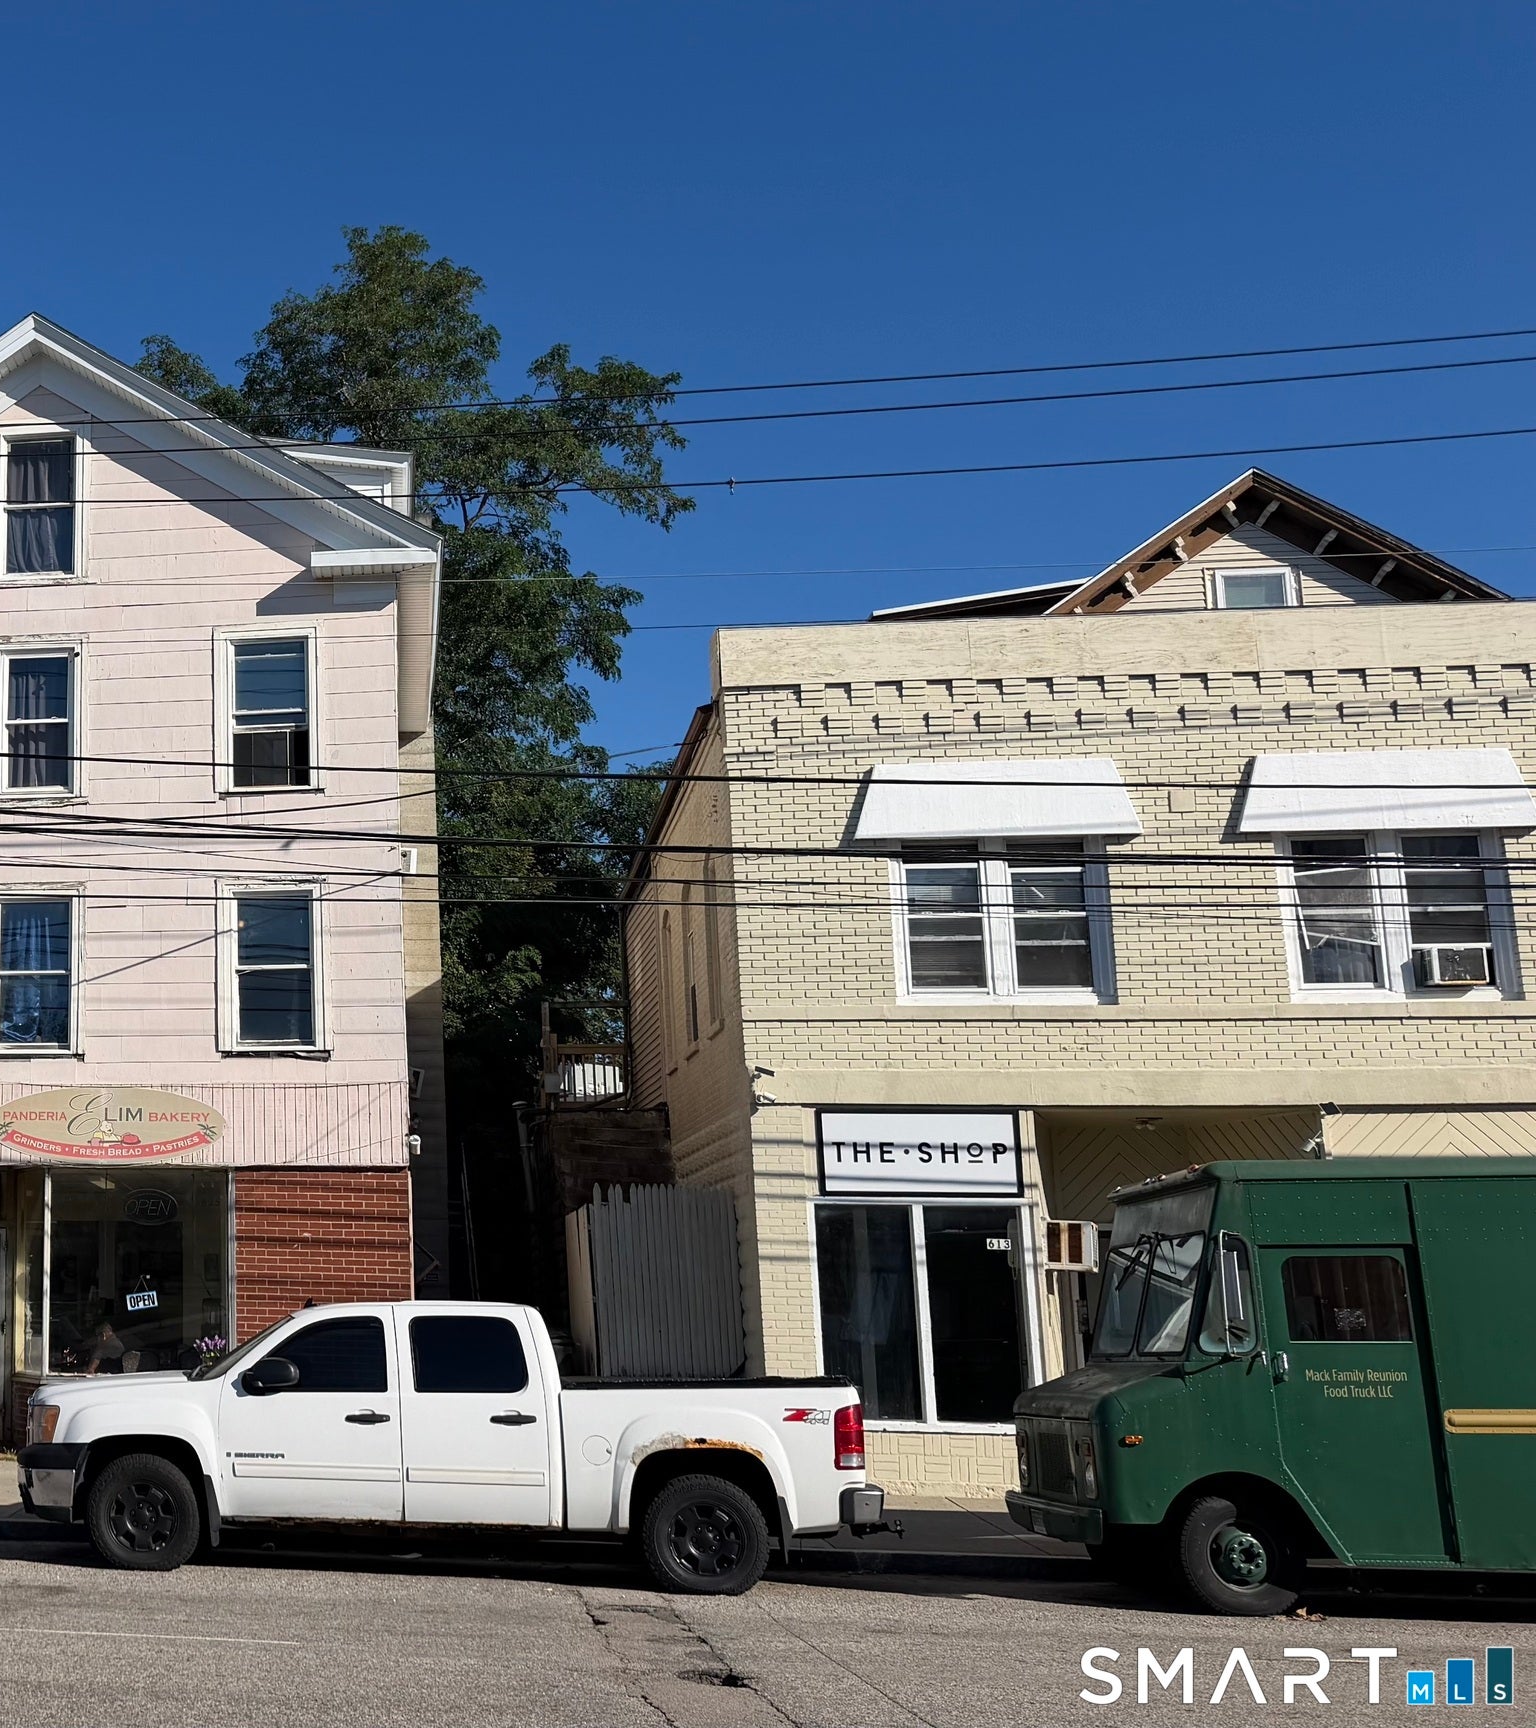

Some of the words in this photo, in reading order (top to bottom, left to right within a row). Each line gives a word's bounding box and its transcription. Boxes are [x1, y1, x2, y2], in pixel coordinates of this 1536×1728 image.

[3, 1111, 67, 1122] PANDERIA
[148, 1112, 211, 1122] BAKERY
[831, 1141, 896, 1163] THE
[917, 1141, 1009, 1164] SHOP
[125, 1199, 171, 1216] OPEN
[988, 1240, 1011, 1250] 613
[129, 1293, 155, 1308] OPEN
[1306, 1369, 1330, 1381] Mack
[1332, 1369, 1364, 1383] Family
[1367, 1369, 1407, 1381] Reunion
[1324, 1385, 1348, 1397] Food
[1351, 1385, 1376, 1397] Truck
[1378, 1385, 1393, 1397] LLC
